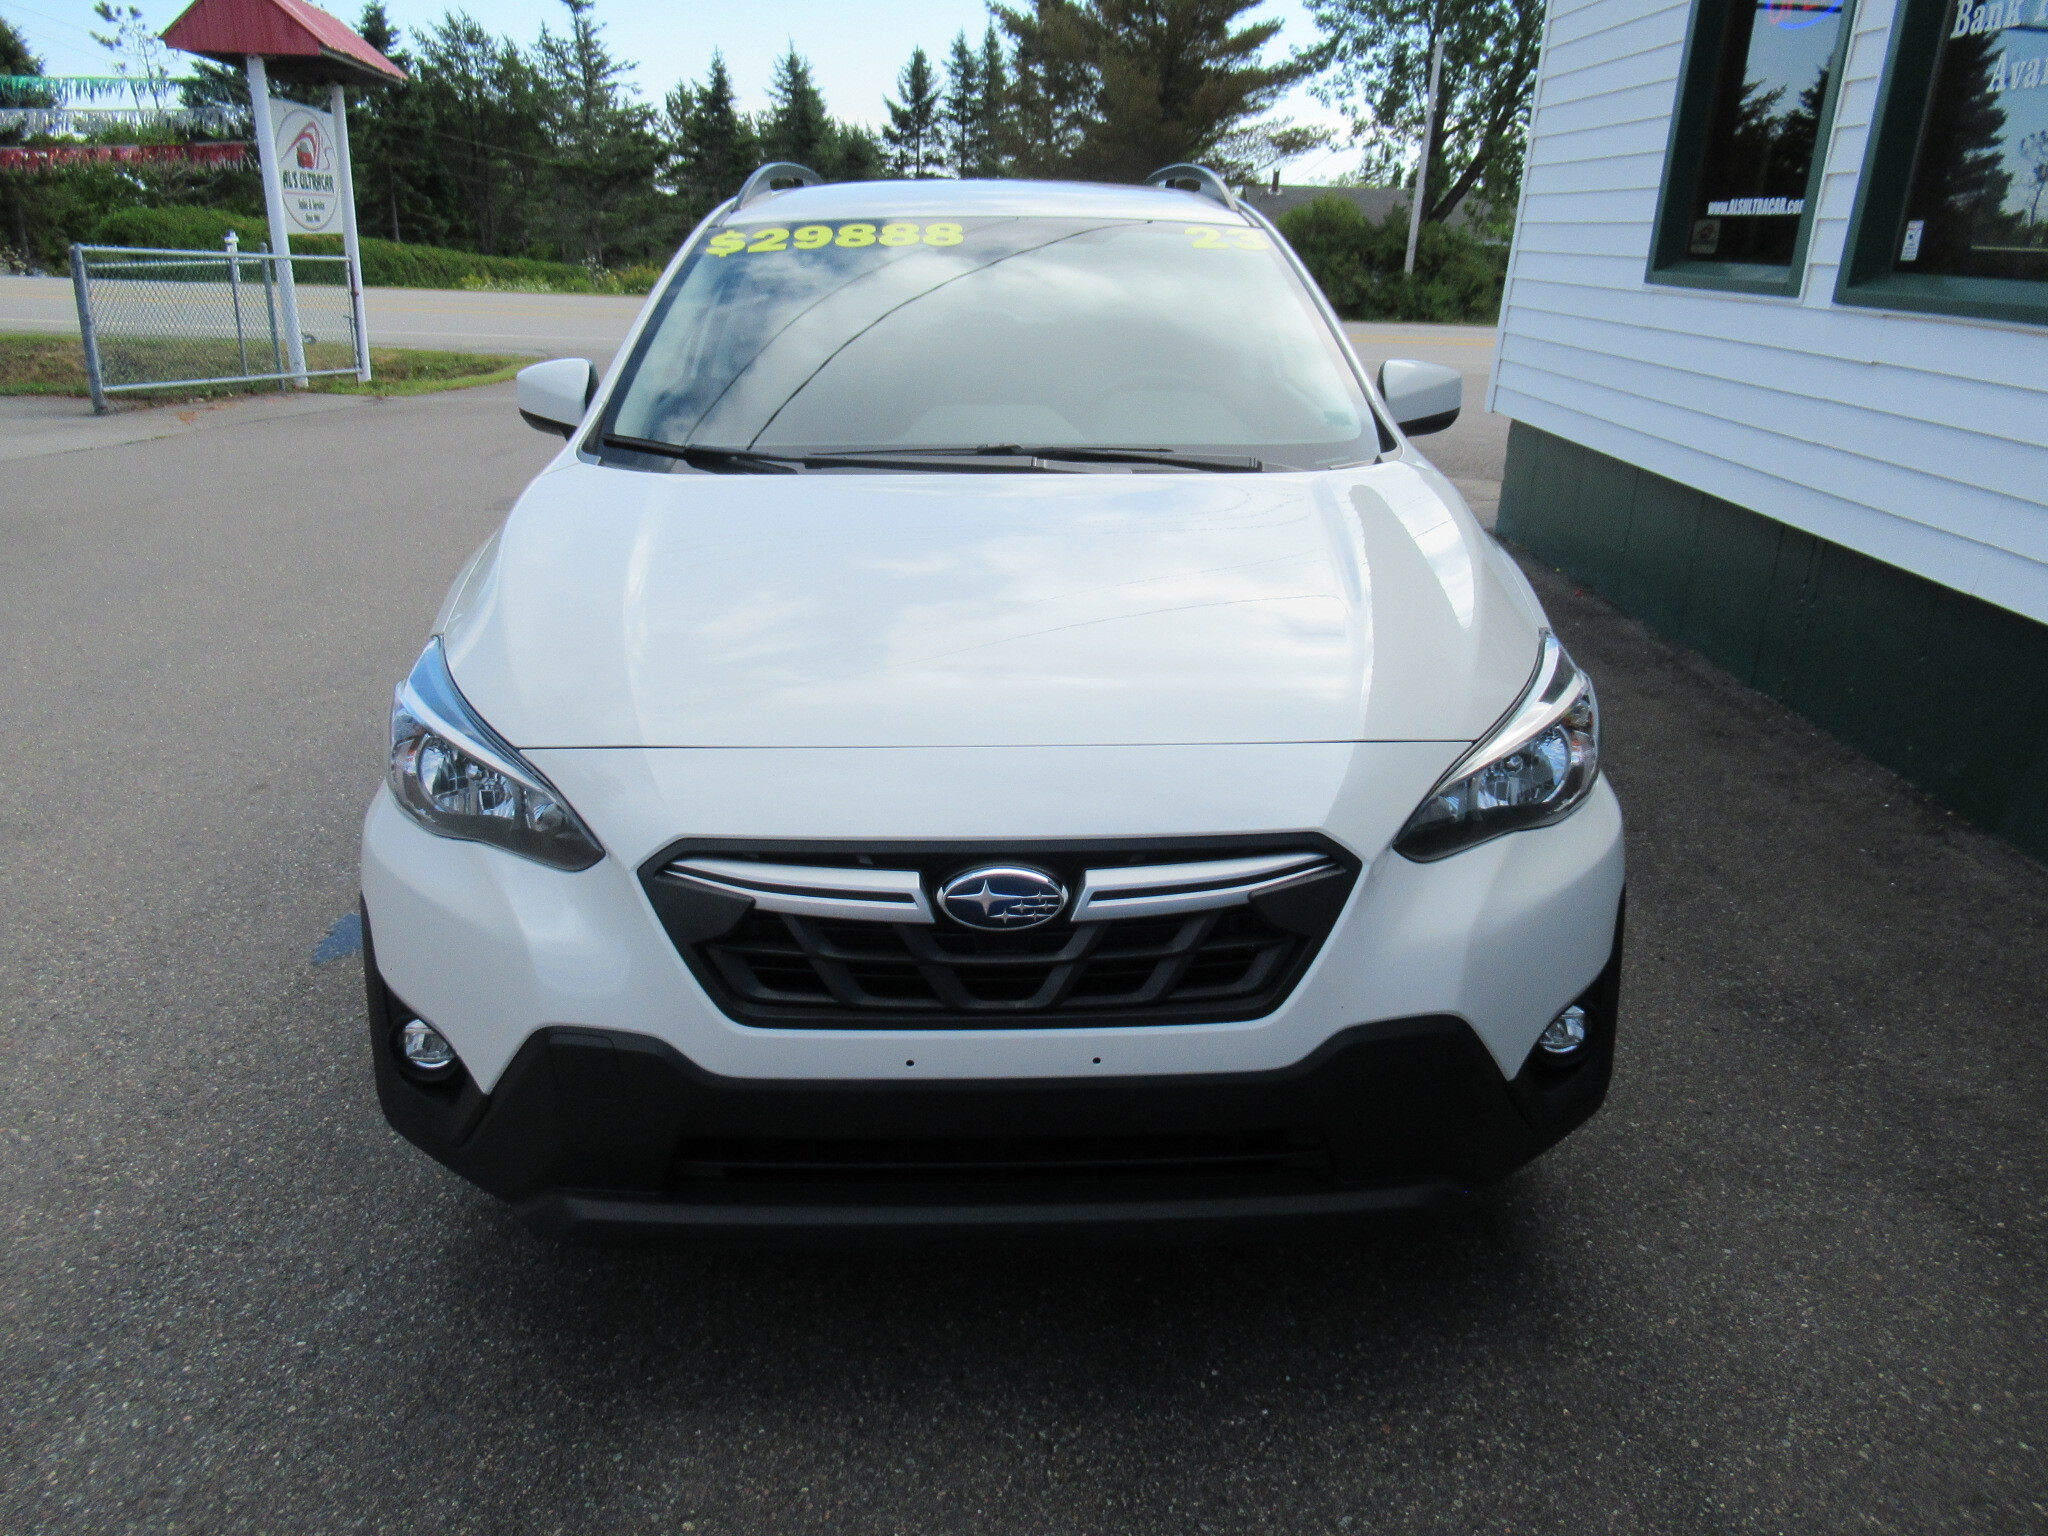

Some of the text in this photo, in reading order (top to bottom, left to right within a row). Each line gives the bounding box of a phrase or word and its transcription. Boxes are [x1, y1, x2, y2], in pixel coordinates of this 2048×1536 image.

[1950, 0, 2020, 39] Bank
[706, 223, 964, 258] $29888
[1184, 225, 1269, 250] 23
